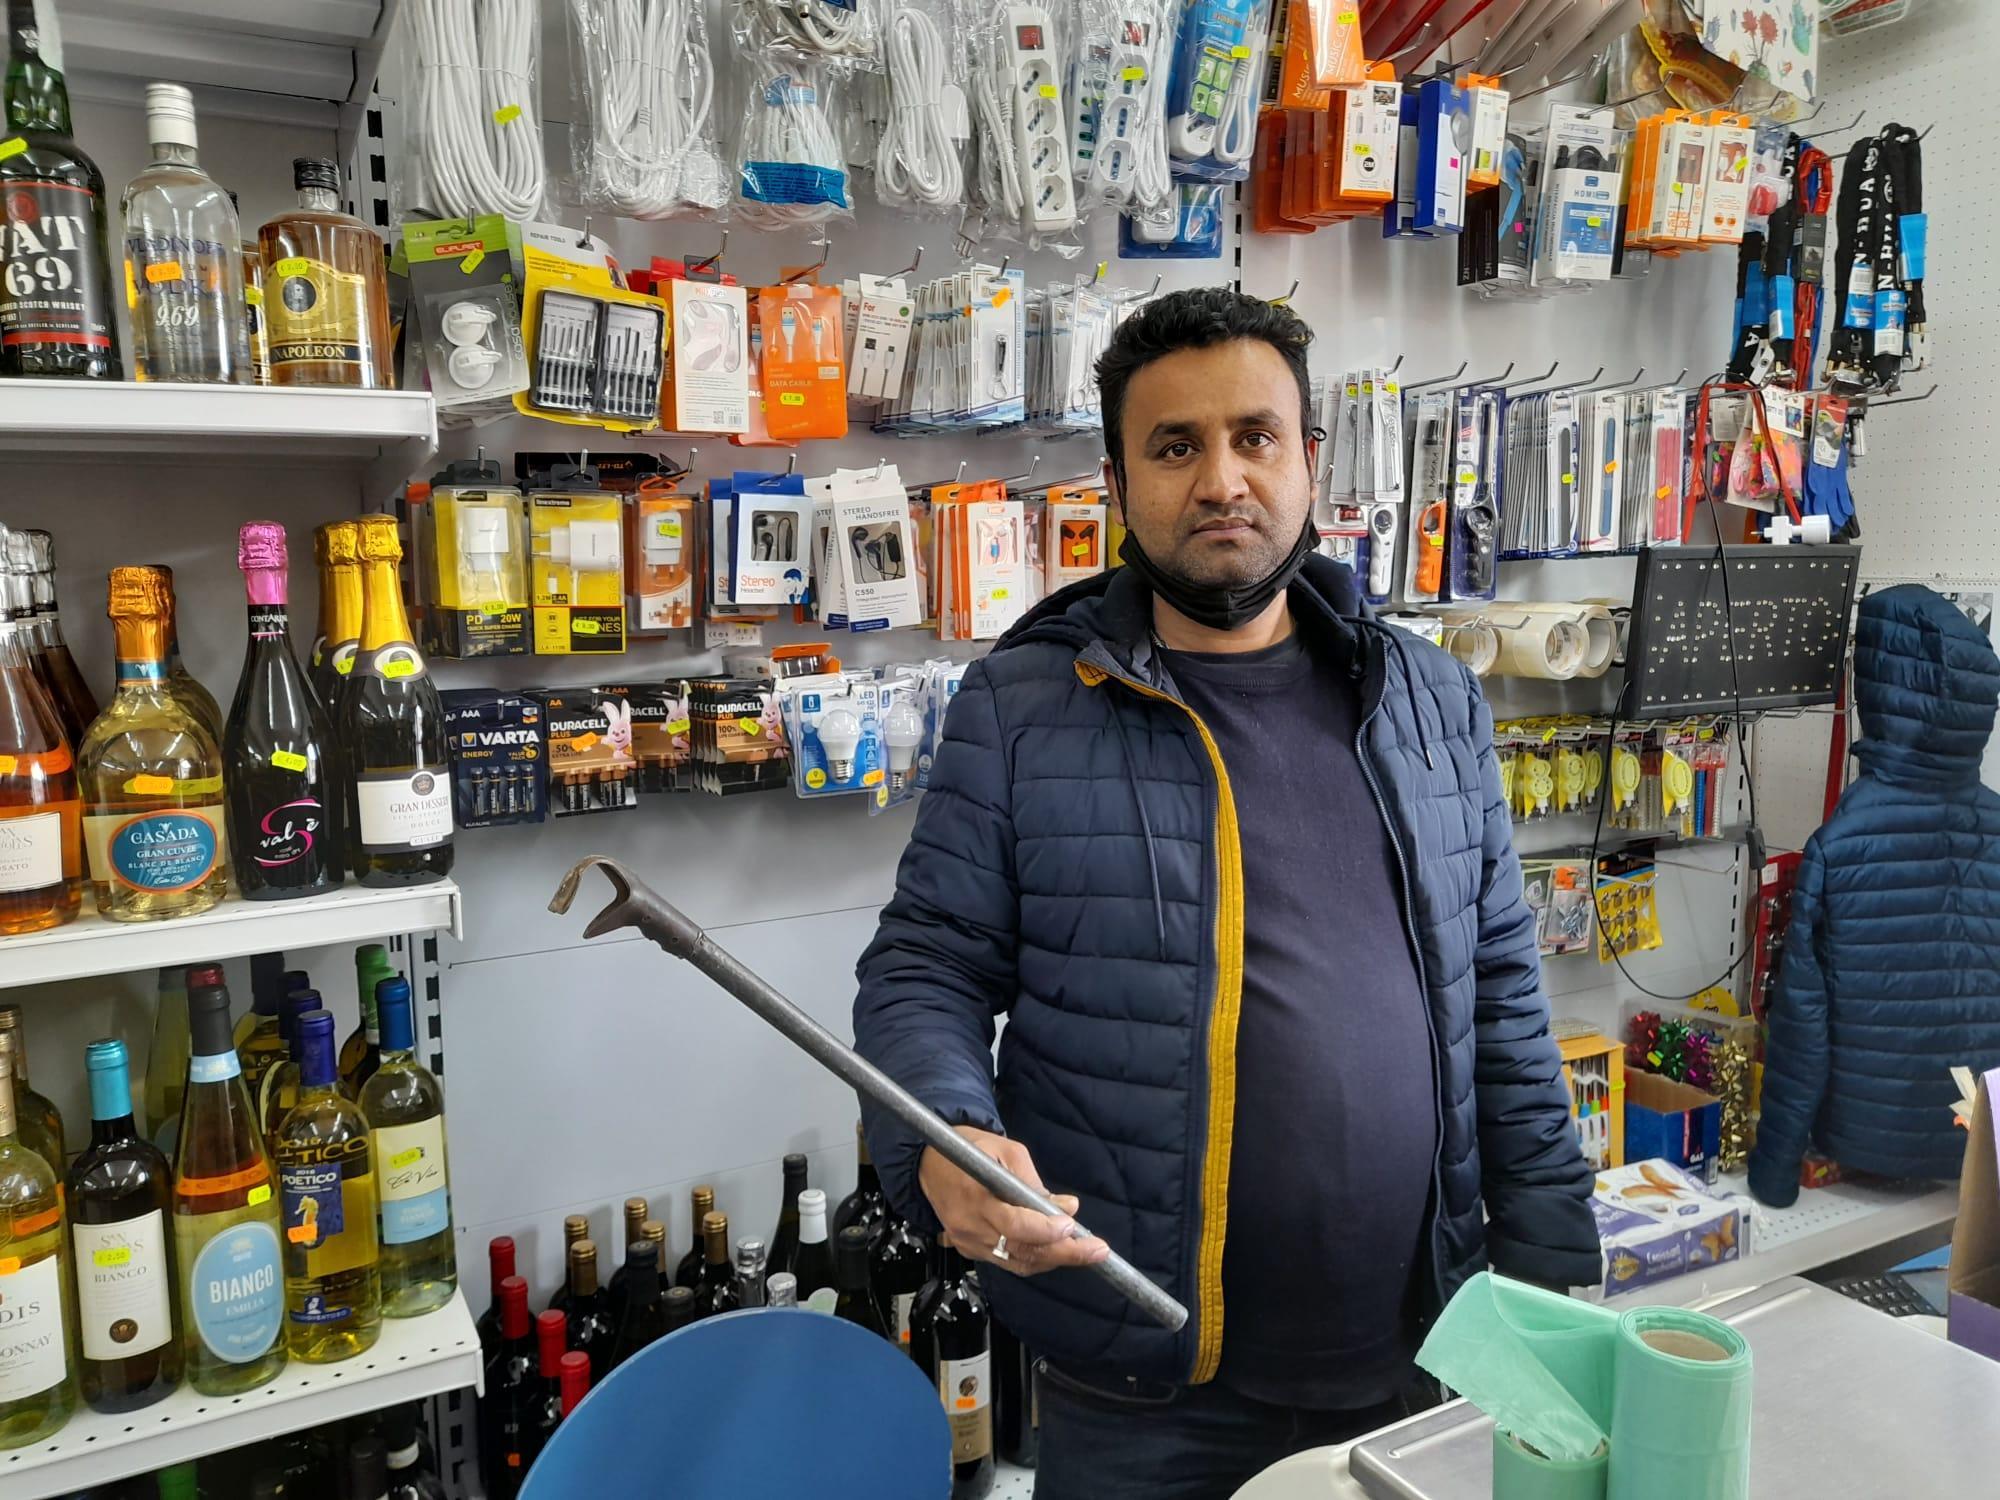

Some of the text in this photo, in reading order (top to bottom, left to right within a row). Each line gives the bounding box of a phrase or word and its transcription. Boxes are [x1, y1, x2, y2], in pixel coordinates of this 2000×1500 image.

[1293, 64, 1311, 98] MUSI
[864, 302, 876, 312] For
[271, 345, 346, 359] NAPOLEON
[843, 506, 872, 517] STEREO
[855, 509, 901, 521] HANDSFREE
[741, 575, 776, 588] Stereo
[466, 614, 483, 626] PD
[500, 612, 522, 624] 20W
[598, 622, 621, 633] NES
[1657, 597, 1832, 665] APERTO
[860, 691, 874, 700] LED
[549, 699, 563, 707] AA
[717, 701, 761, 714] DURACELL
[461, 709, 481, 719] AAA
[627, 706, 666, 717] RACELL
[718, 712, 734, 720] PLUS
[550, 718, 608, 732] DURACELL
[478, 730, 540, 746] VARTA
[462, 750, 494, 759] ENERGY
[390, 802, 419, 814] GRAN
[130, 826, 199, 845] CASADA
[136, 849, 165, 859] GRAN
[1689, 1152, 1704, 1163] GAS
[281, 1172, 337, 1186] POETICO
[95, 1265, 148, 1283] BIANCO
[210, 1264, 274, 1304] BIANCO
